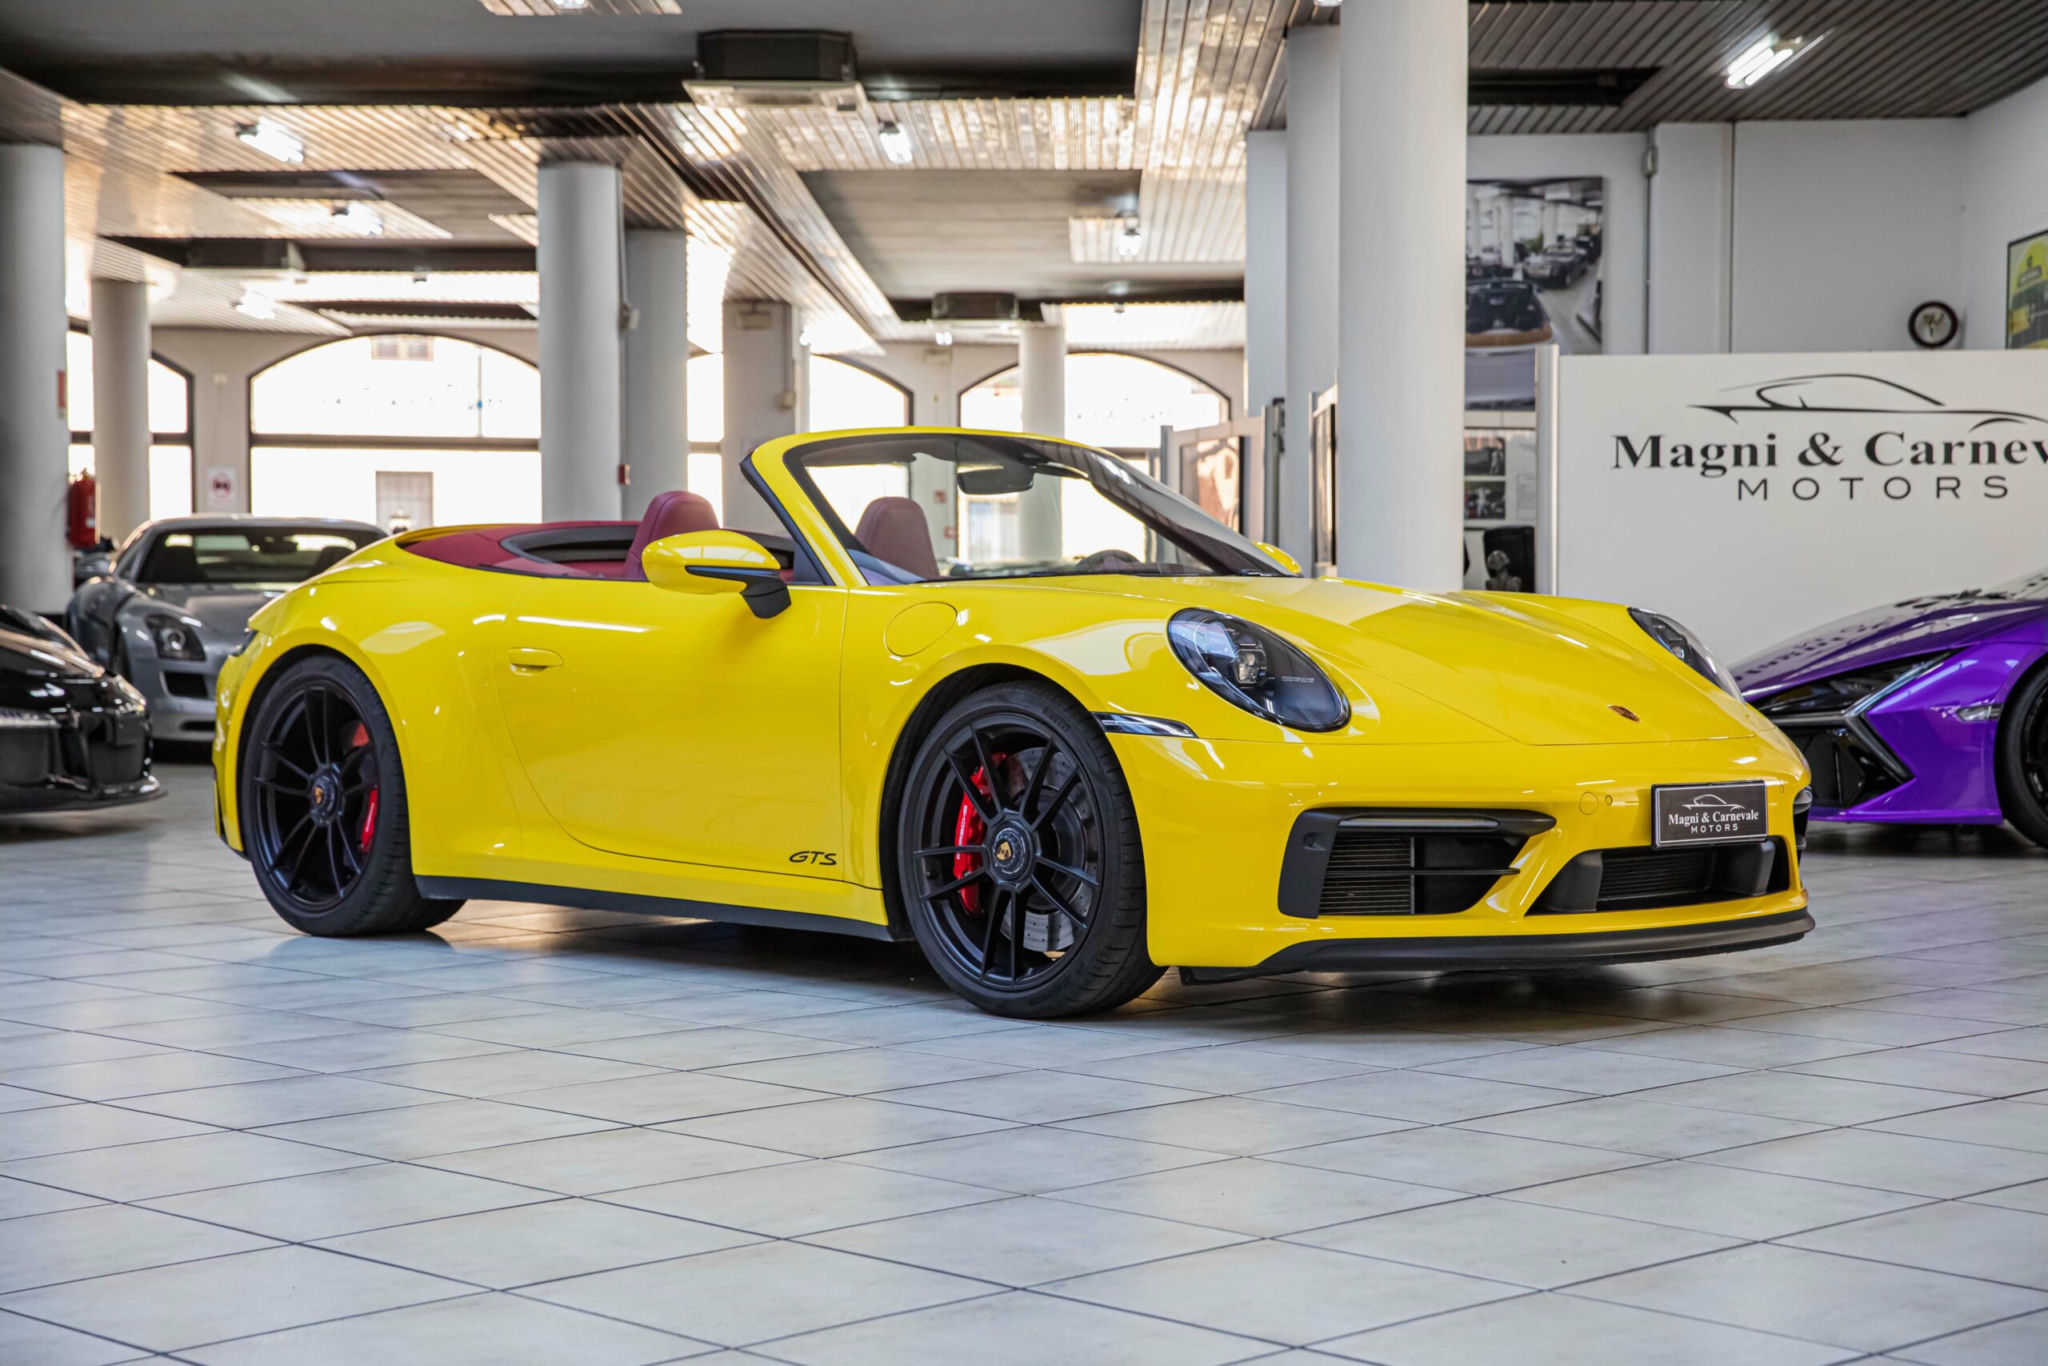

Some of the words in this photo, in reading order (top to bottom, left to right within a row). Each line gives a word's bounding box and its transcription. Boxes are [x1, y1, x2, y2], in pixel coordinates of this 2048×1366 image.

[1611, 433, 1778, 478] Magni
[1798, 431, 1844, 468] &
[1737, 475, 2009, 501] MOTORS
[1668, 812, 1699, 827] Magni
[1701, 812, 1710, 823] &
[1712, 809, 1759, 822] Carnevale
[1691, 823, 1738, 834] MOTORS
[789, 850, 837, 866] GTS
